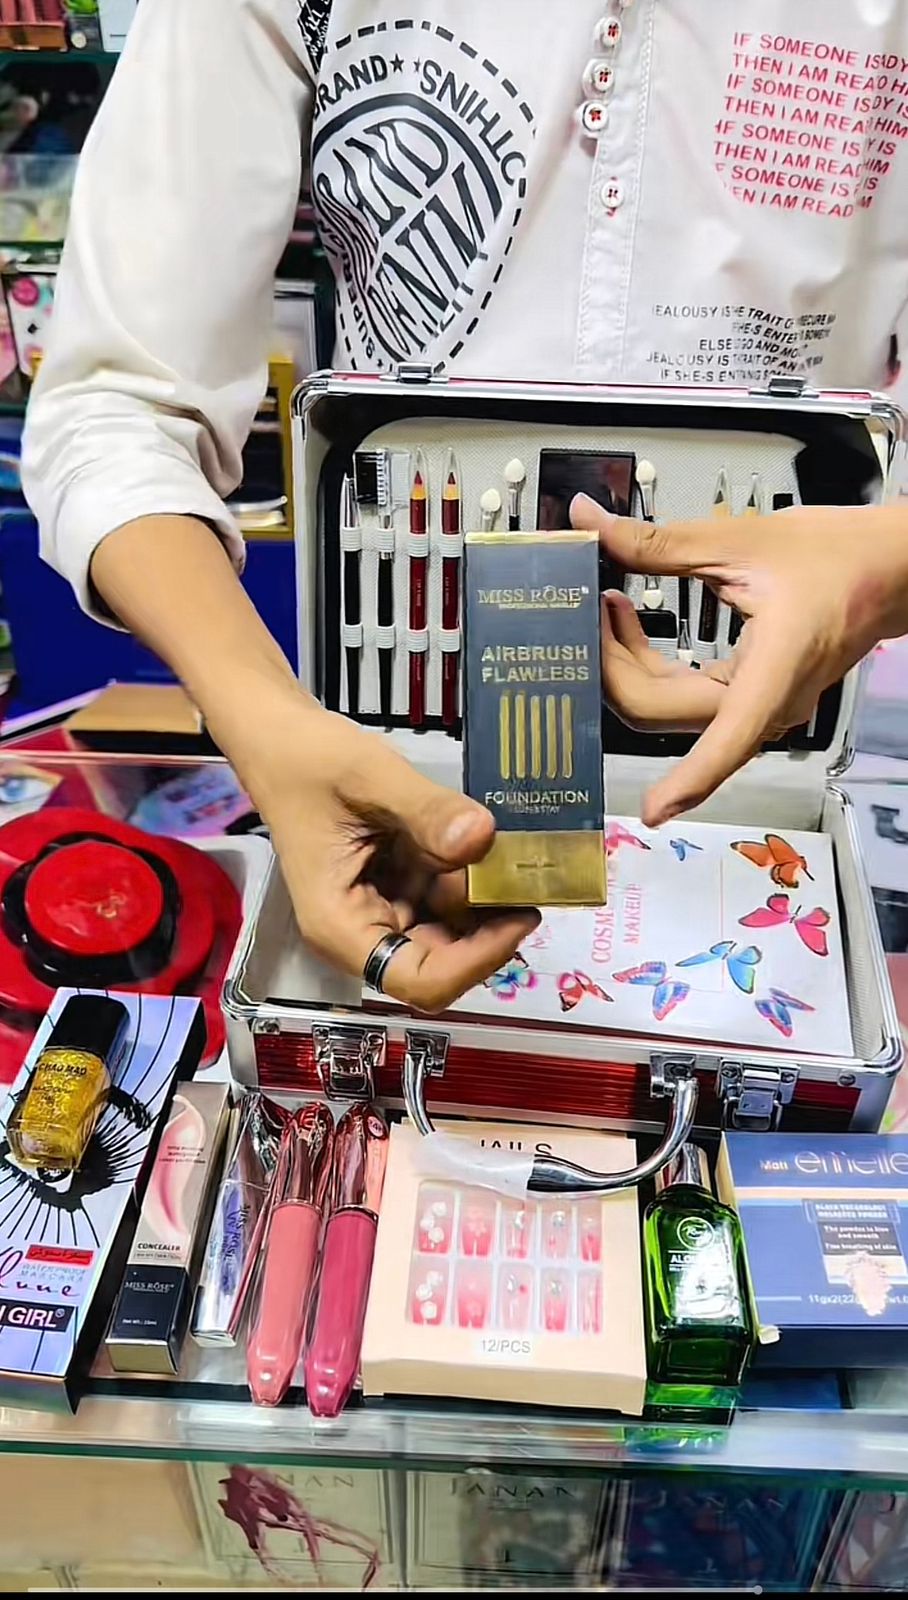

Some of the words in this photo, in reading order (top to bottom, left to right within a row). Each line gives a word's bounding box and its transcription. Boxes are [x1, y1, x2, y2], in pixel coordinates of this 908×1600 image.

[733, 31, 752, 47] IF
[759, 33, 859, 68] SOMEONE
[733, 53, 783, 75] THEN
[799, 64, 829, 83] AM
[726, 73, 746, 89] IF
[751, 77, 849, 108] SOMEONE
[853, 96, 871, 113] IS
[724, 96, 776, 118] THEN
[790, 107, 819, 124] AM
[823, 112, 864, 134] REA
[742, 123, 838, 151] SOMEONE
[842, 140, 860, 157] IS
[877, 139, 896, 156] IS
[714, 140, 768, 163] THEN
[782, 152, 811, 169] AM
[731, 164, 825, 193] SOMEONE
[830, 181, 849, 197] IS
[770, 193, 797, 209] AM
[747, 307, 784, 327] TRAIT
[699, 338, 733, 351] ELSE
[754, 340, 780, 354] AND
[717, 354, 730, 367] IS
[477, 587, 525, 604] MISS
[481, 644, 590, 662] AIRBRUSH
[481, 666, 590, 683] FLAWLESS
[485, 789, 590, 805] FOUNDATION
[623, 883, 642, 944] MAKEUP
[137, 1243, 181, 1251] CONCEALER
[8, 1306, 57, 1329] GIRL
[481, 1338, 532, 1354] 12/PCS
